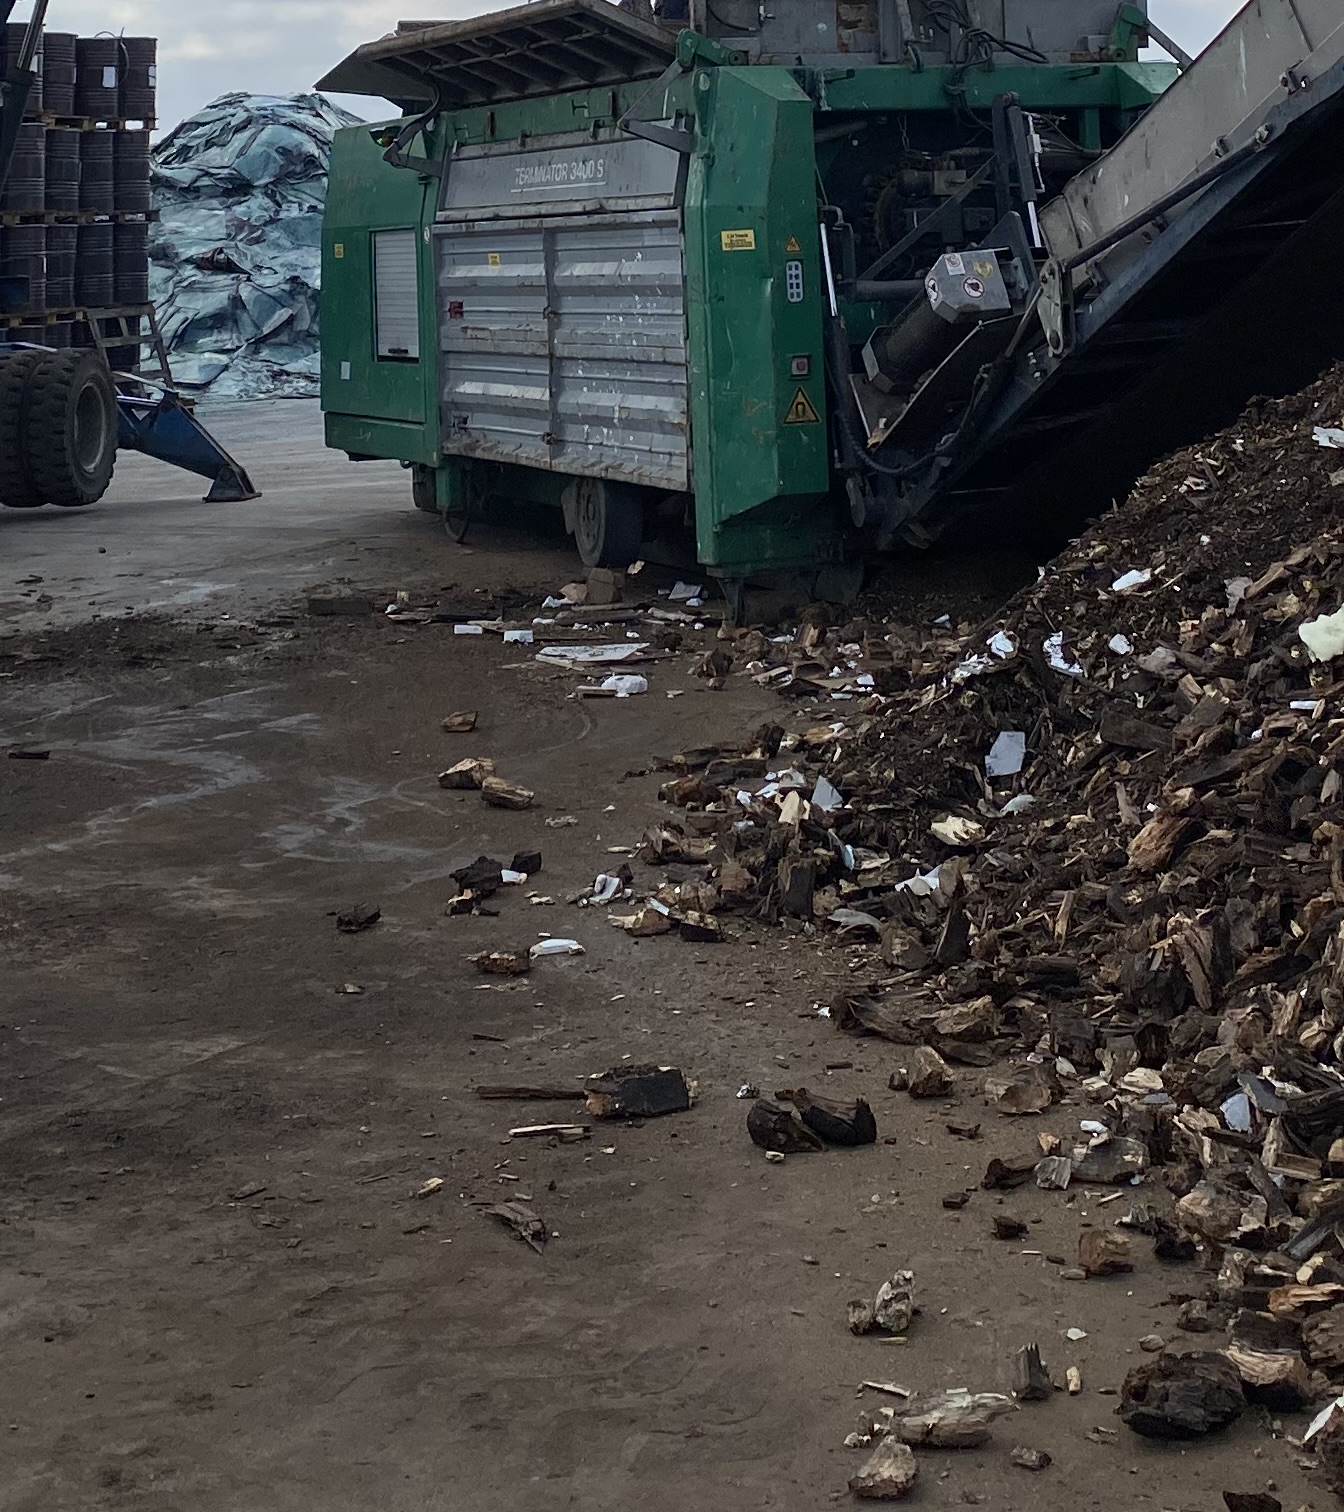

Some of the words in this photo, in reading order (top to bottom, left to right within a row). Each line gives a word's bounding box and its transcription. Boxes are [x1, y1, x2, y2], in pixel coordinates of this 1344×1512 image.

[515, 162, 568, 185] TERMINATOR
[569, 159, 595, 181] 3400
[596, 158, 604, 178] S
